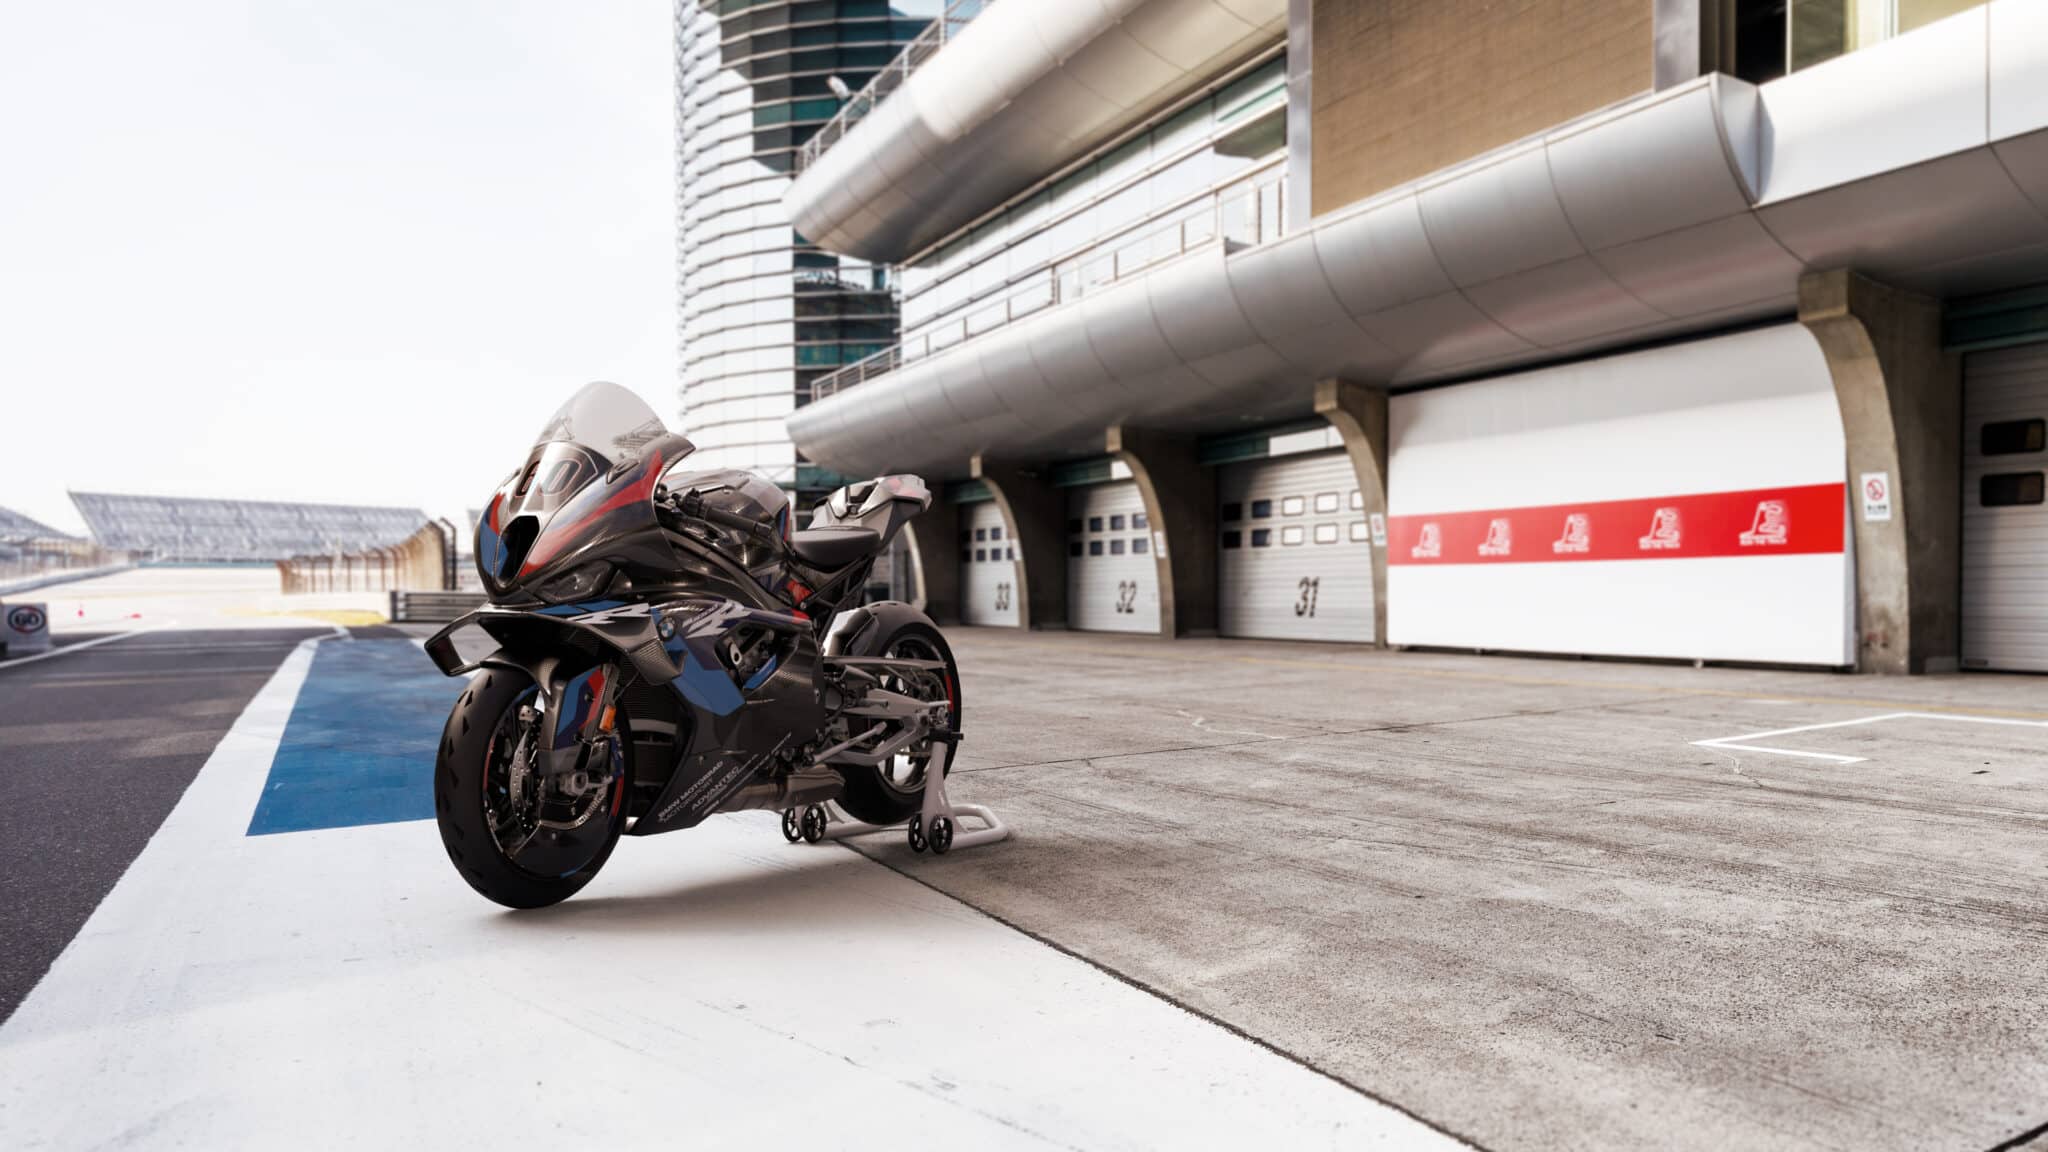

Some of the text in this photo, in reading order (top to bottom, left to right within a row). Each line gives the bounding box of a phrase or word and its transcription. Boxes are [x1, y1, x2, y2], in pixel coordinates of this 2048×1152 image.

[995, 582, 1011, 611] 33
[1117, 580, 1137, 613] 32
[1294, 576, 1320, 617] 31
[658, 760, 723, 819] BMW MOTORRAD
